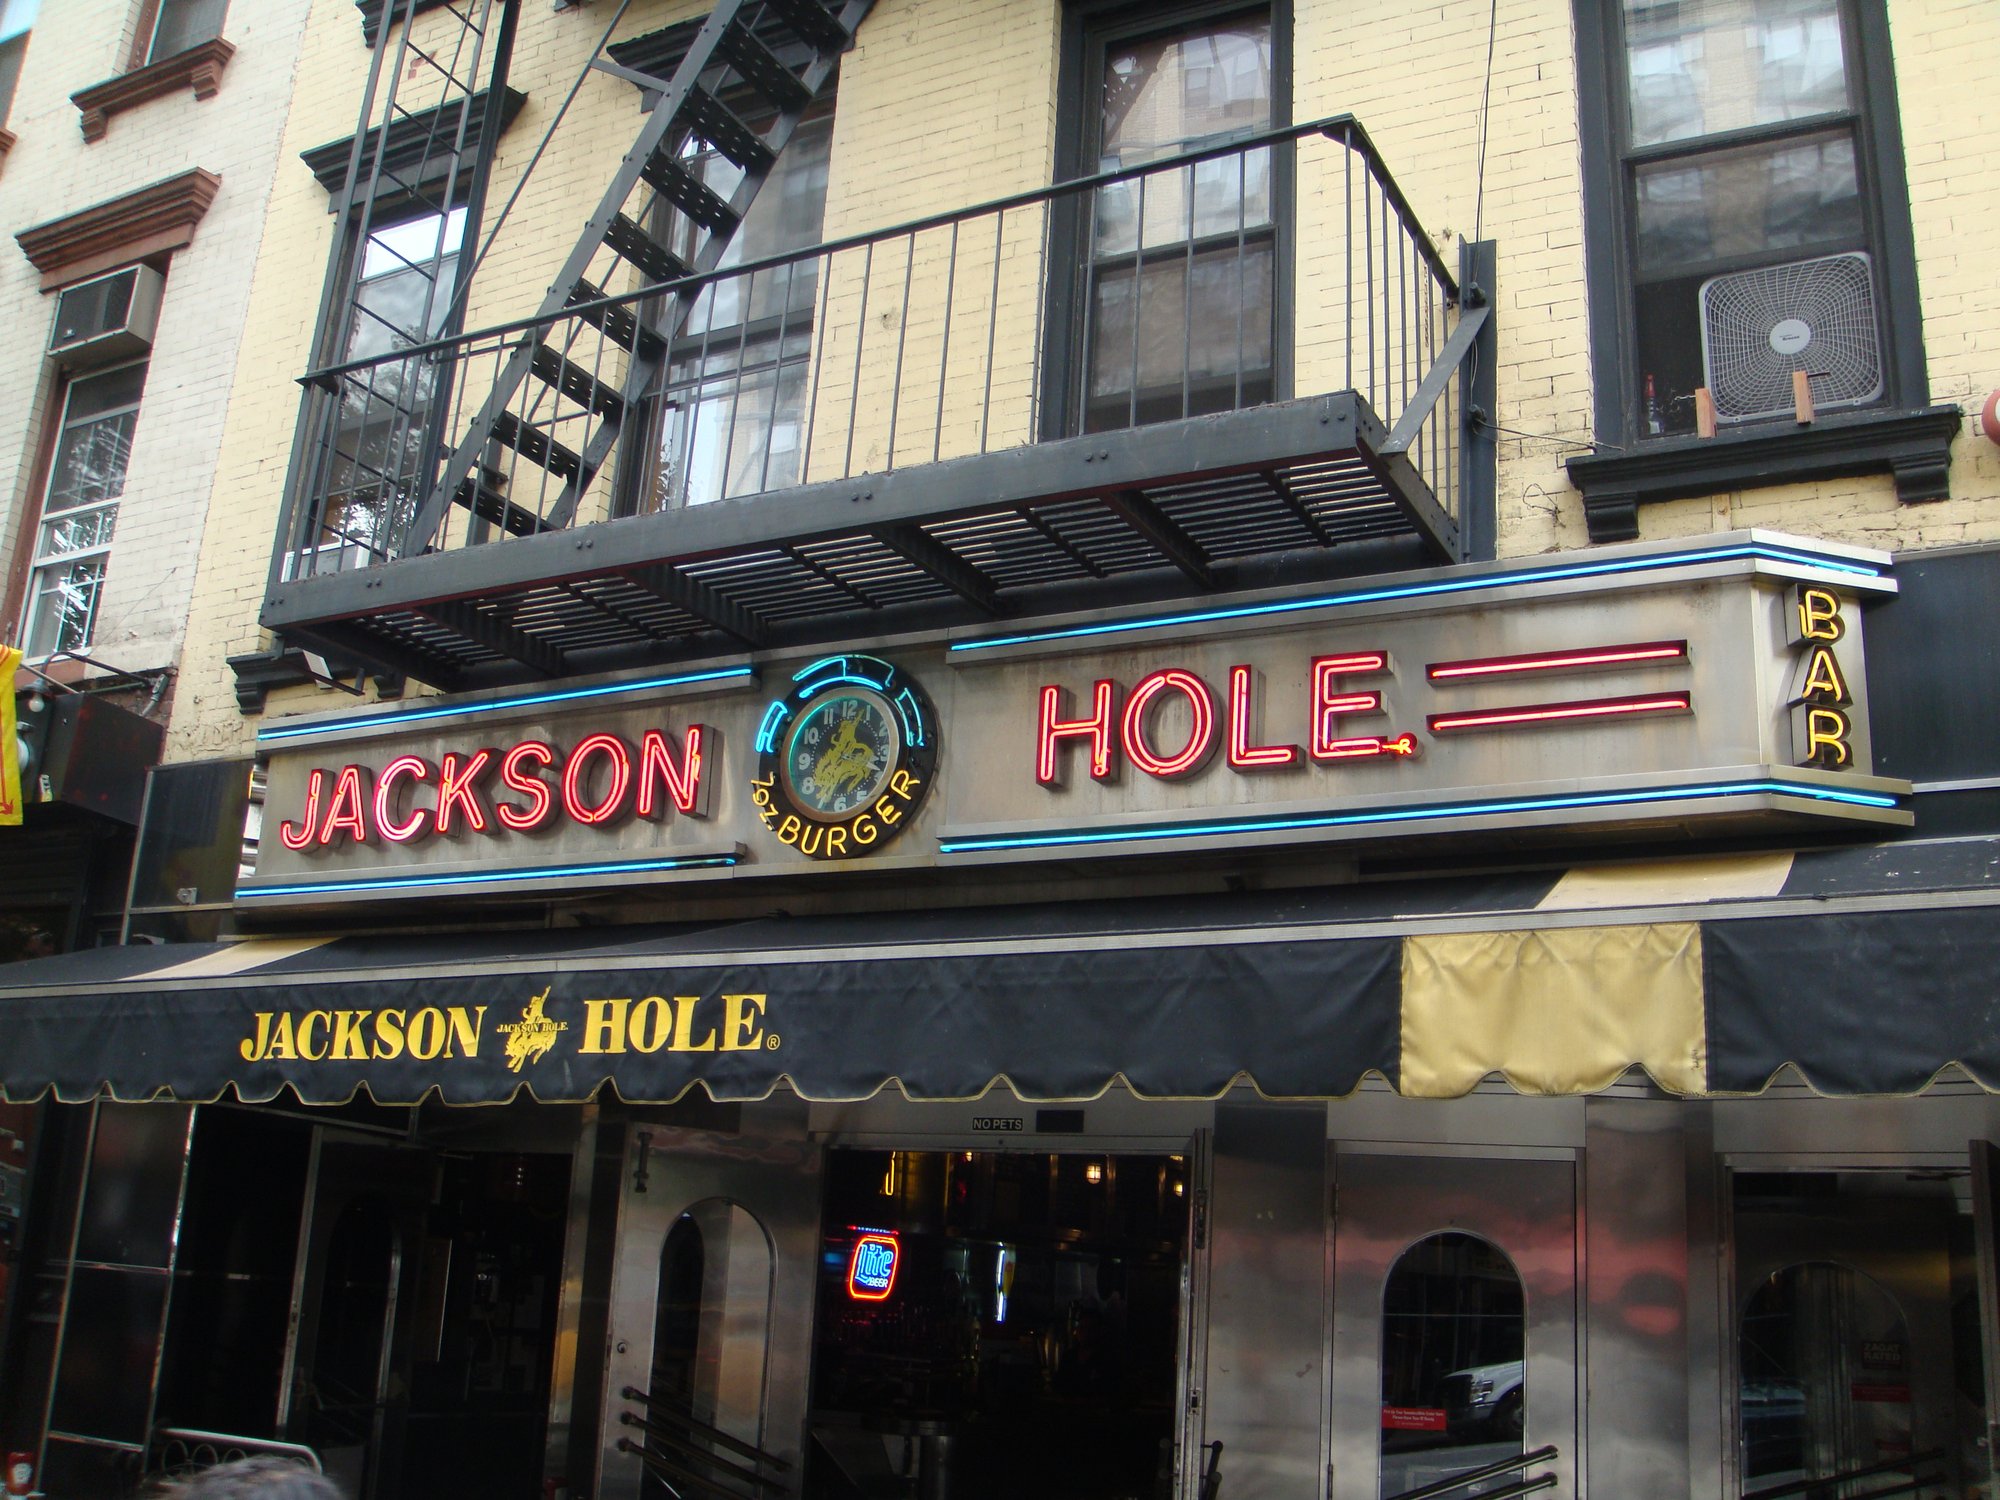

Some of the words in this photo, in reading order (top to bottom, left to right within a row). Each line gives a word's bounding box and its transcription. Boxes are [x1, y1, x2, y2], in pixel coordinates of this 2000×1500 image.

[1797, 584, 1853, 767] BAR
[824, 709, 834, 725] 11
[843, 701, 858, 718] 12
[866, 705, 871, 720] 1
[804, 727, 819, 745] 10
[281, 723, 708, 852] JACKSON
[1035, 649, 1389, 787] HOLE
[798, 753, 810, 770] 9
[801, 776, 815, 795] 8
[834, 796, 846, 812] 6
[777, 769, 921, 857] BURGER
[240, 1005, 488, 1062] JACKSON
[577, 994, 767, 1054] HOLE
[496, 1022, 540, 1033] JACKSON
[973, 1118, 991, 1130] NO
[993, 1118, 1022, 1130] PETS
[855, 1243, 894, 1284] Lite
[867, 1276, 889, 1288] BEER
